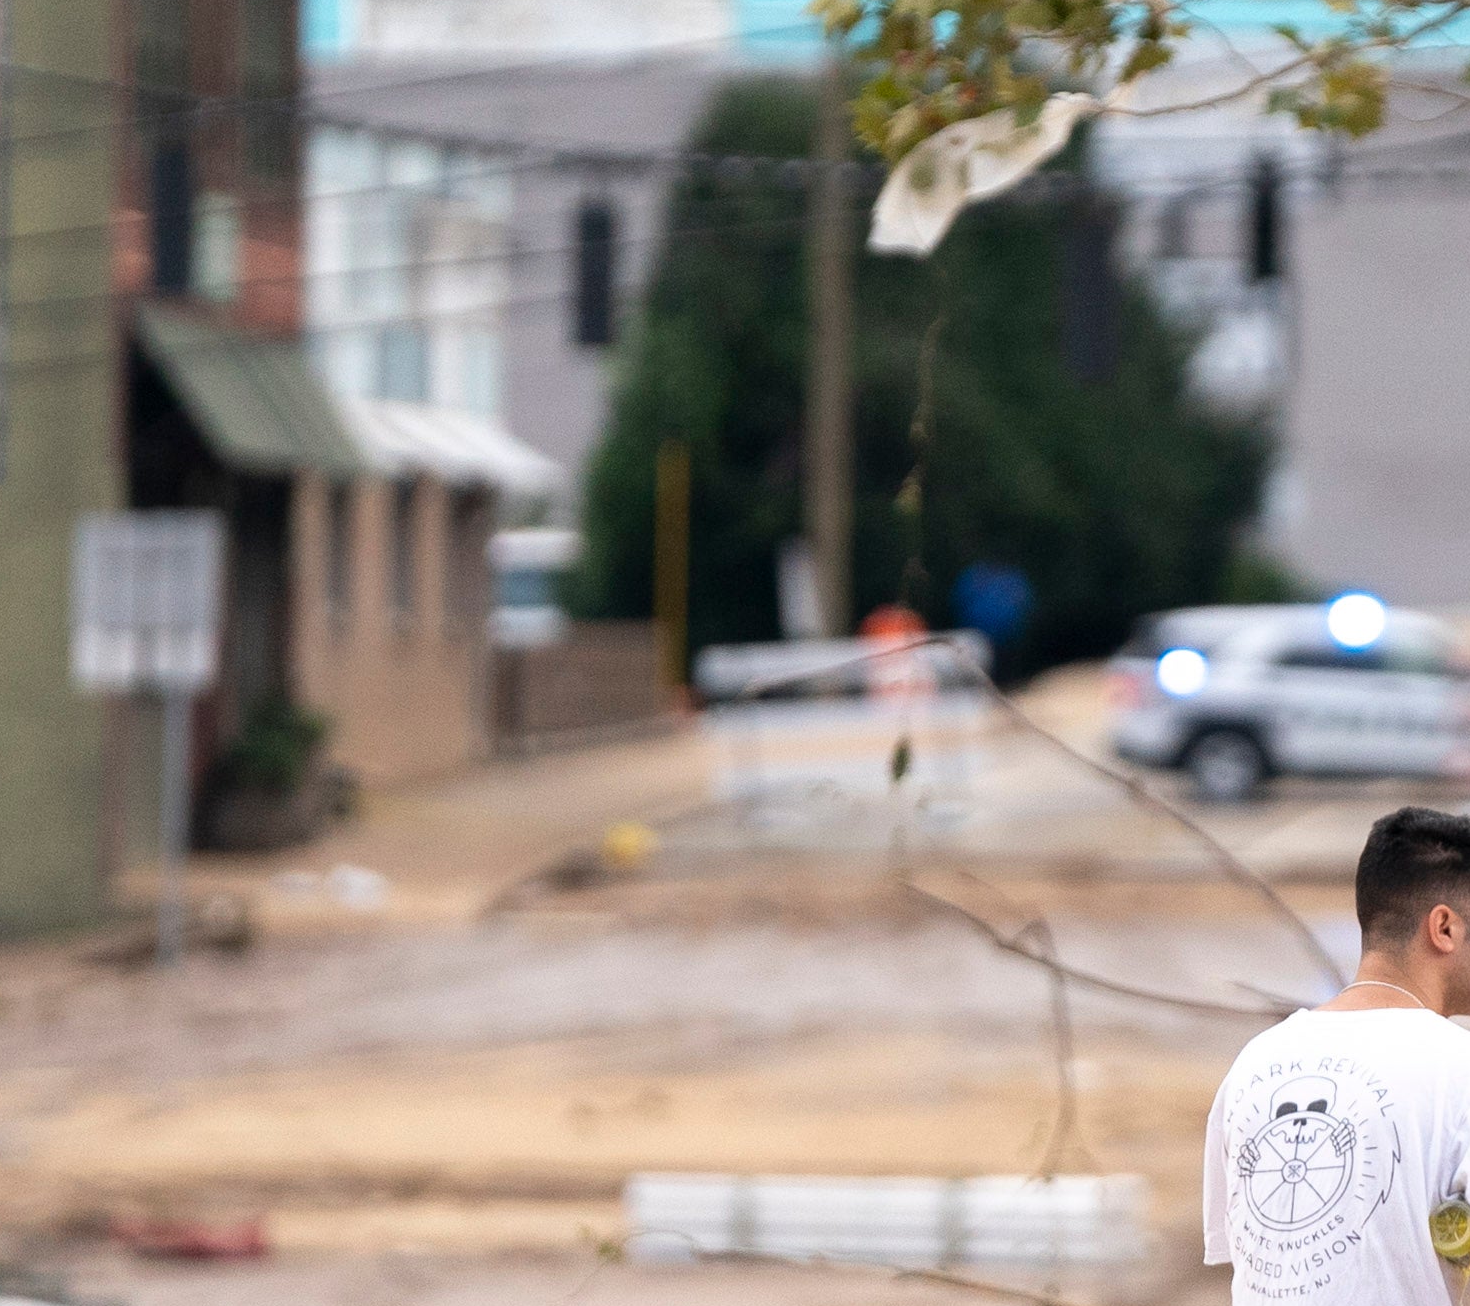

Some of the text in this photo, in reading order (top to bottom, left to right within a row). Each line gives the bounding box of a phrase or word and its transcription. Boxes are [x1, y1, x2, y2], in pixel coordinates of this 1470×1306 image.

[1318, 1057, 1395, 1117] REVIVAL
[1235, 1230, 1362, 1278] SHADED VISION
[1243, 1214, 1345, 1252] WHITE KNUCKLES
[1314, 1274, 1331, 1290] NJ
